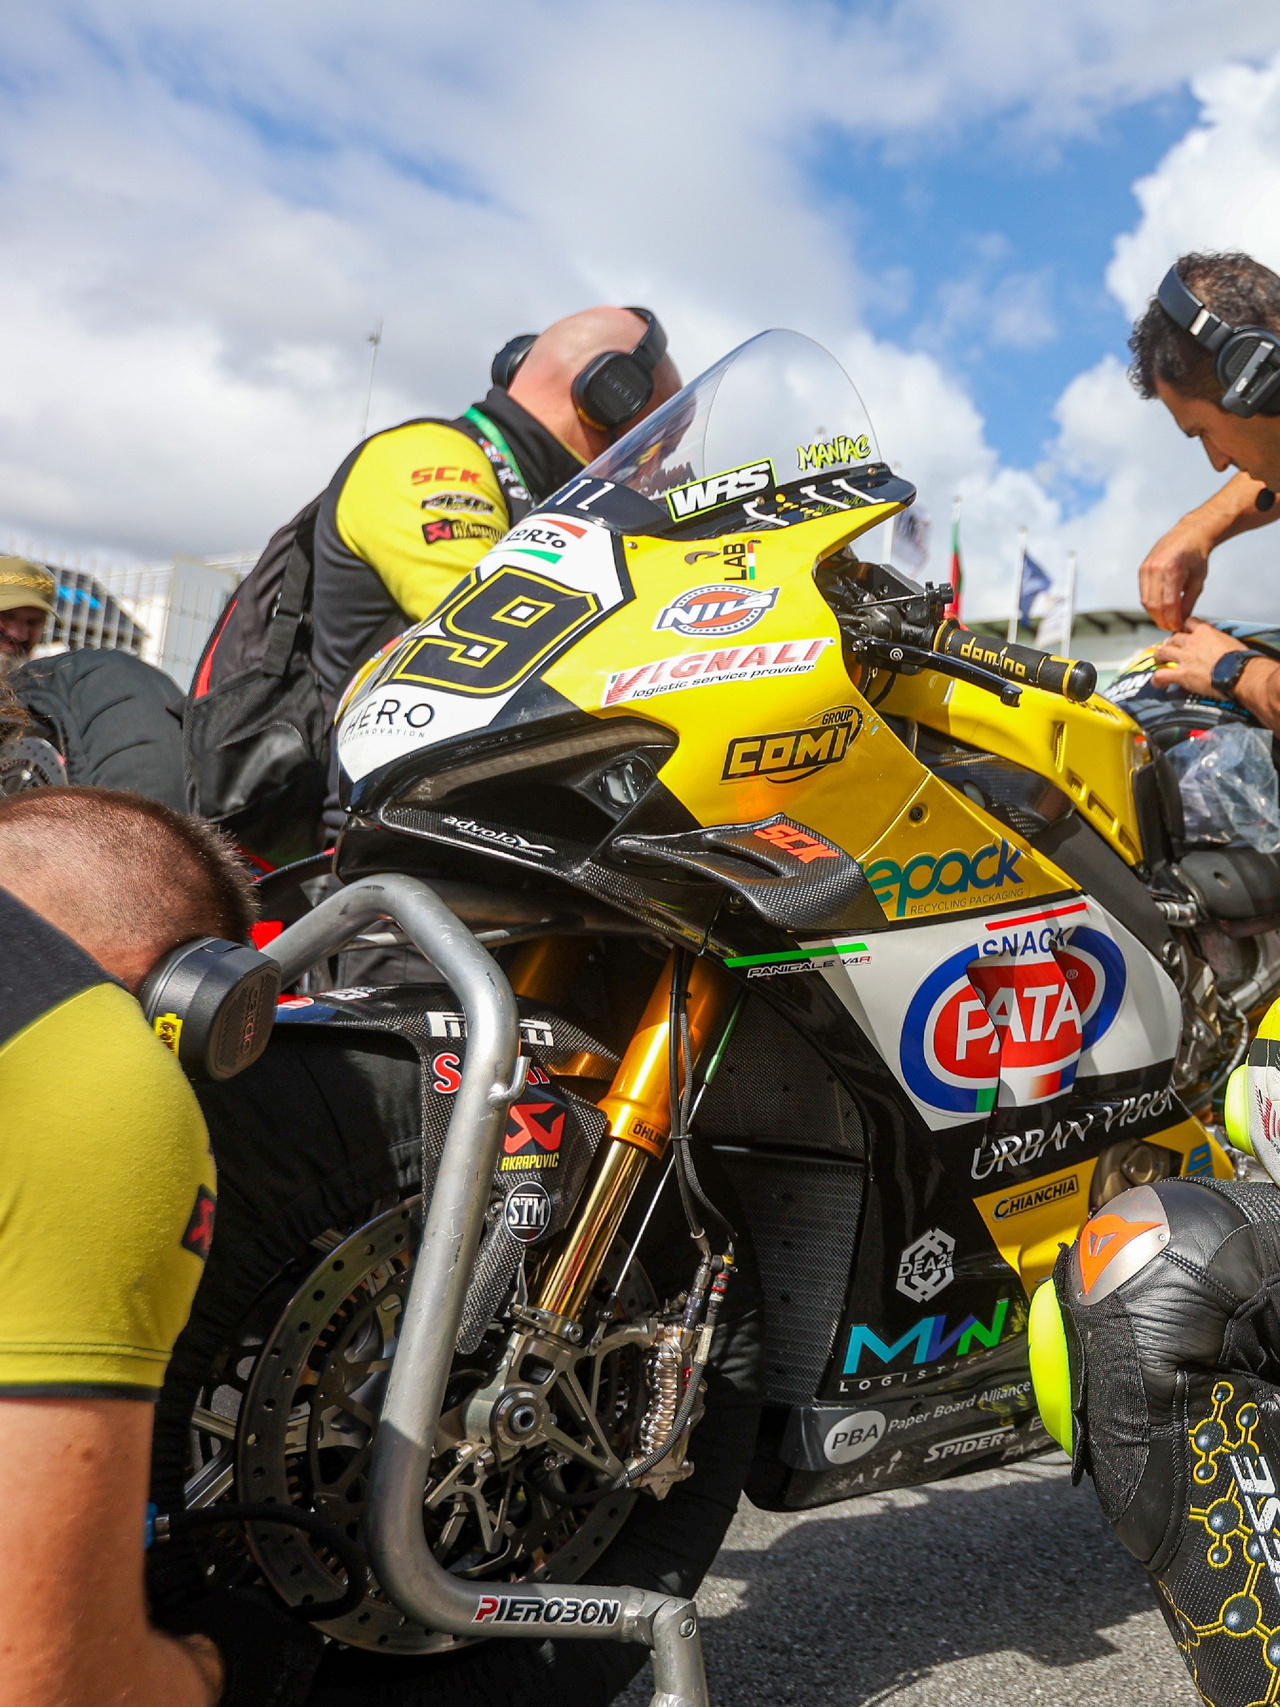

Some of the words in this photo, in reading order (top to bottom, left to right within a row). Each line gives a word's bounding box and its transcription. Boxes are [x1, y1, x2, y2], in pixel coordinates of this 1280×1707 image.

[411, 466, 482, 486] SCK
[673, 462, 771, 518] WRS
[724, 543, 748, 581] LAB
[656, 587, 780, 629] NILS
[605, 640, 824, 704] VIGNALI
[960, 637, 1026, 677] domino
[632, 679, 689, 698] logistic
[692, 672, 748, 686] service
[751, 663, 815, 680] provider
[822, 709, 854, 725] GROUP
[728, 726, 849, 775] COMI
[753, 823, 841, 864] SCK
[859, 838, 1024, 917] epack
[911, 900, 967, 915] RECYCLING
[969, 887, 1025, 906] PACKAGING
[983, 927, 1068, 957] SNACK
[747, 960, 835, 978] PANIGALE
[955, 984, 1083, 1060] PATA
[971, 1113, 1094, 1180] URBAN
[508, 1197, 547, 1226] STM
[992, 1180, 1077, 1220] CHIANCHIA
[831, 1423, 880, 1451] PBA
[888, 1411, 931, 1432] Paper
[933, 1395, 976, 1418] Board
[976, 1381, 1031, 1404] Alliance
[923, 1425, 1015, 1464] SPIDER
[473, 1597, 621, 1626] PIEROBON
